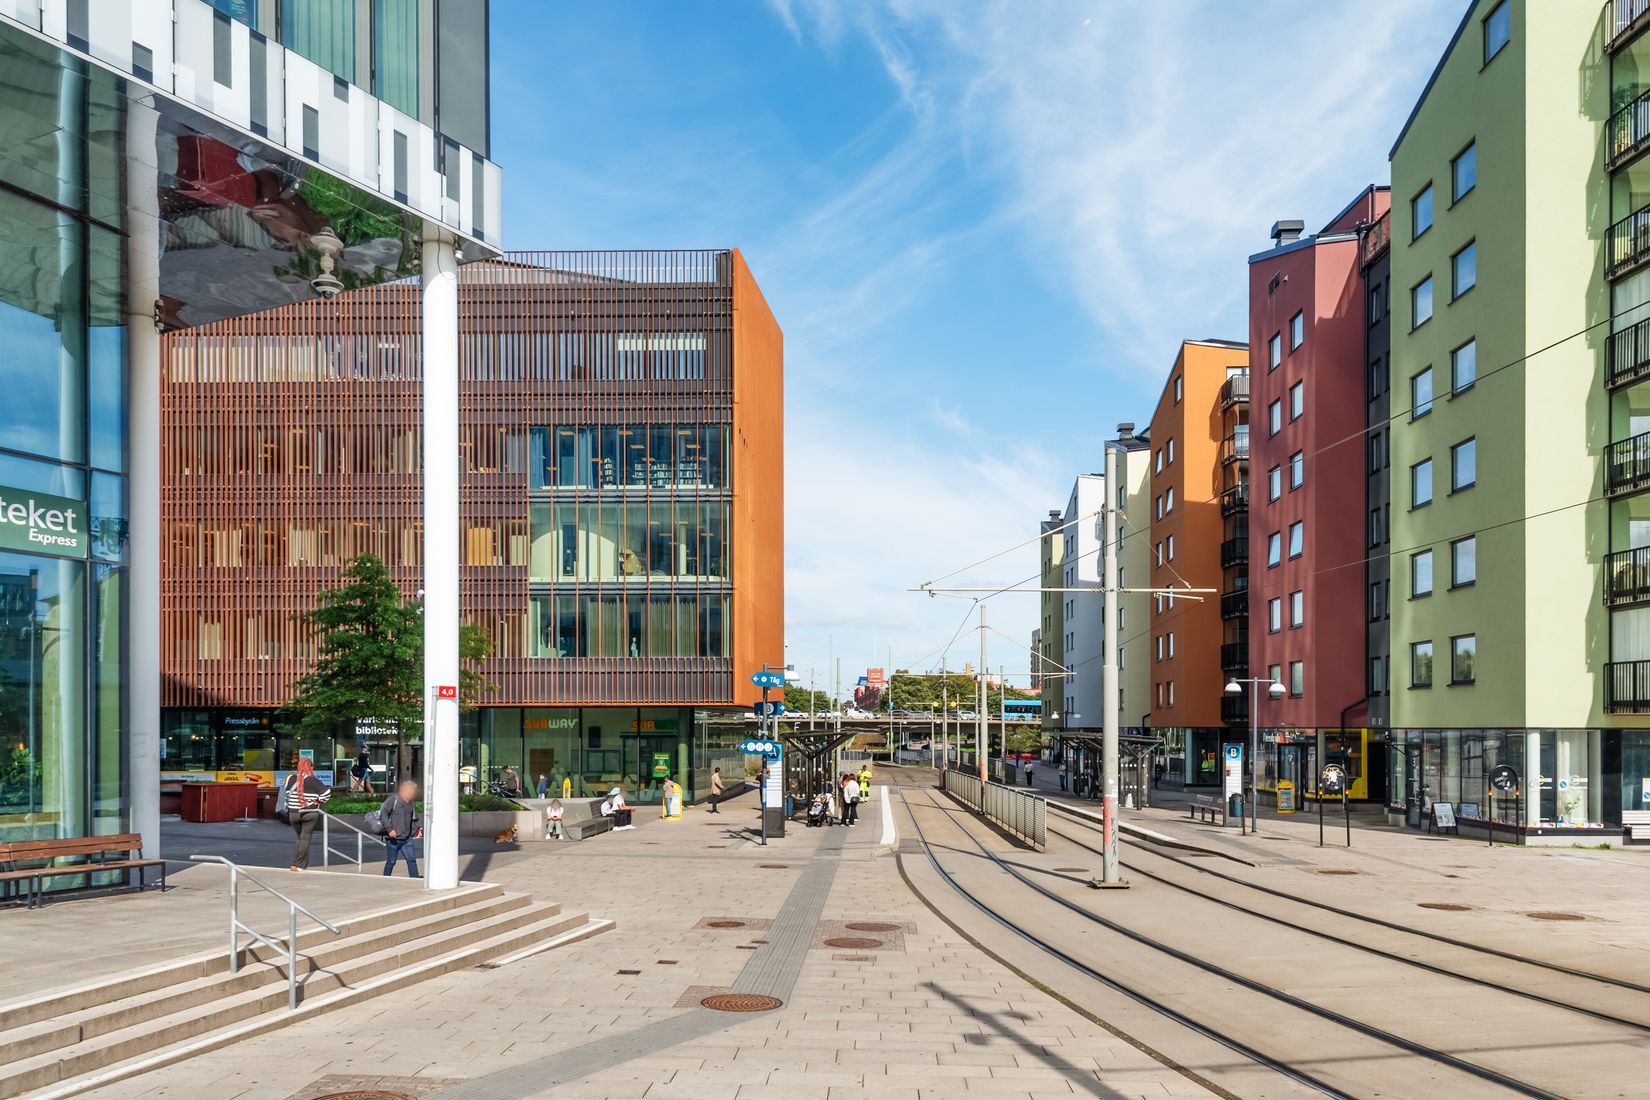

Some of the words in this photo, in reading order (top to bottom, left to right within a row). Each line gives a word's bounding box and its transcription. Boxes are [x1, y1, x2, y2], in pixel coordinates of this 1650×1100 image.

[29, 528, 77, 547] Express
[770, 676, 780, 684] Tåg
[441, 688, 454, 696] 4,0
[224, 716, 260, 726] Pressbyrån
[525, 719, 579, 728] SUBWAY
[1230, 748, 1237, 757] B
